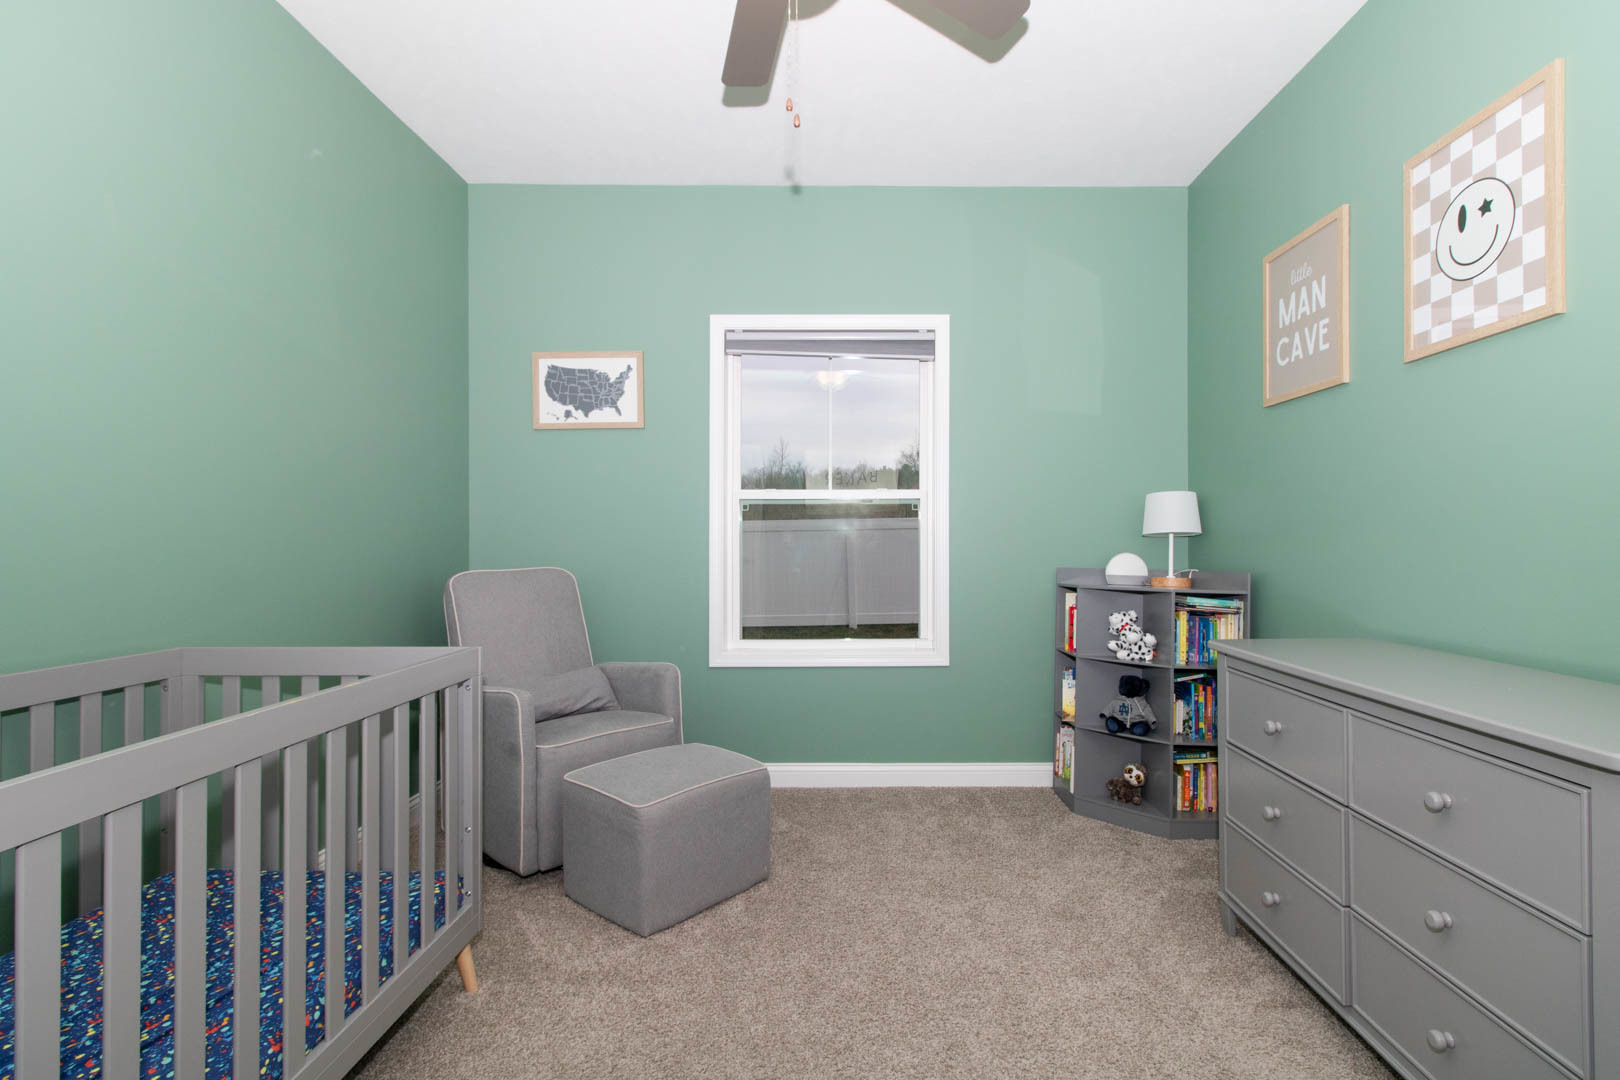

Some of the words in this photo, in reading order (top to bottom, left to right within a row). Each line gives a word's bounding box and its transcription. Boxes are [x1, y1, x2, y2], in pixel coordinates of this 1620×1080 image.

[1290, 262, 1313, 285] little
[1278, 275, 1327, 329] MAN
[1276, 318, 1330, 367] CAVE
